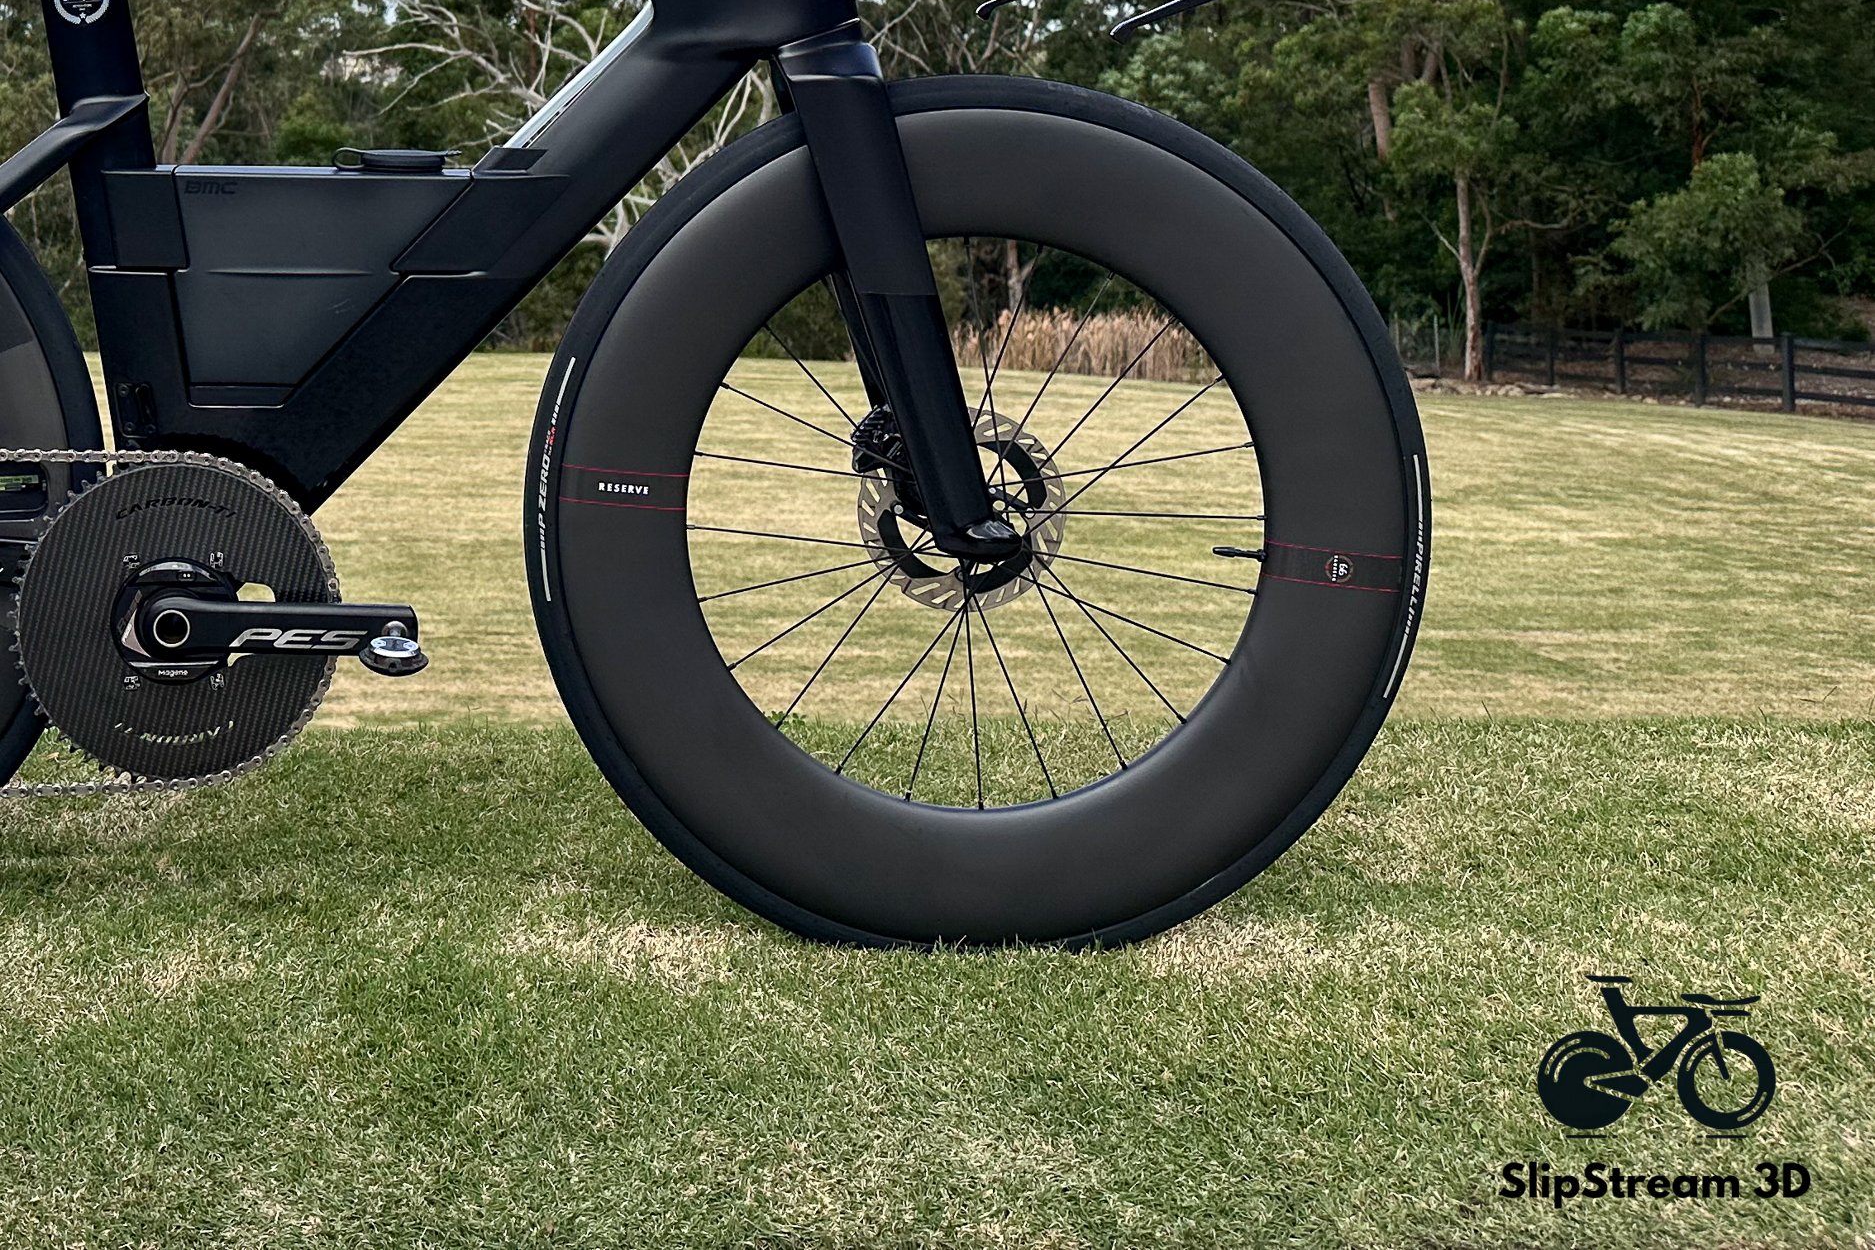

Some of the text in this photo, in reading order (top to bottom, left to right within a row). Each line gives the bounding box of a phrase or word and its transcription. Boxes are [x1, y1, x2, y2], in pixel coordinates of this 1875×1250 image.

[184, 180, 238, 195] BMC
[537, 454, 551, 530] P ZERO
[598, 482, 649, 495] RESERVE
[114, 496, 238, 521] CARBON-TI
[1408, 542, 1423, 616] PIRELLI
[229, 628, 367, 651] PES
